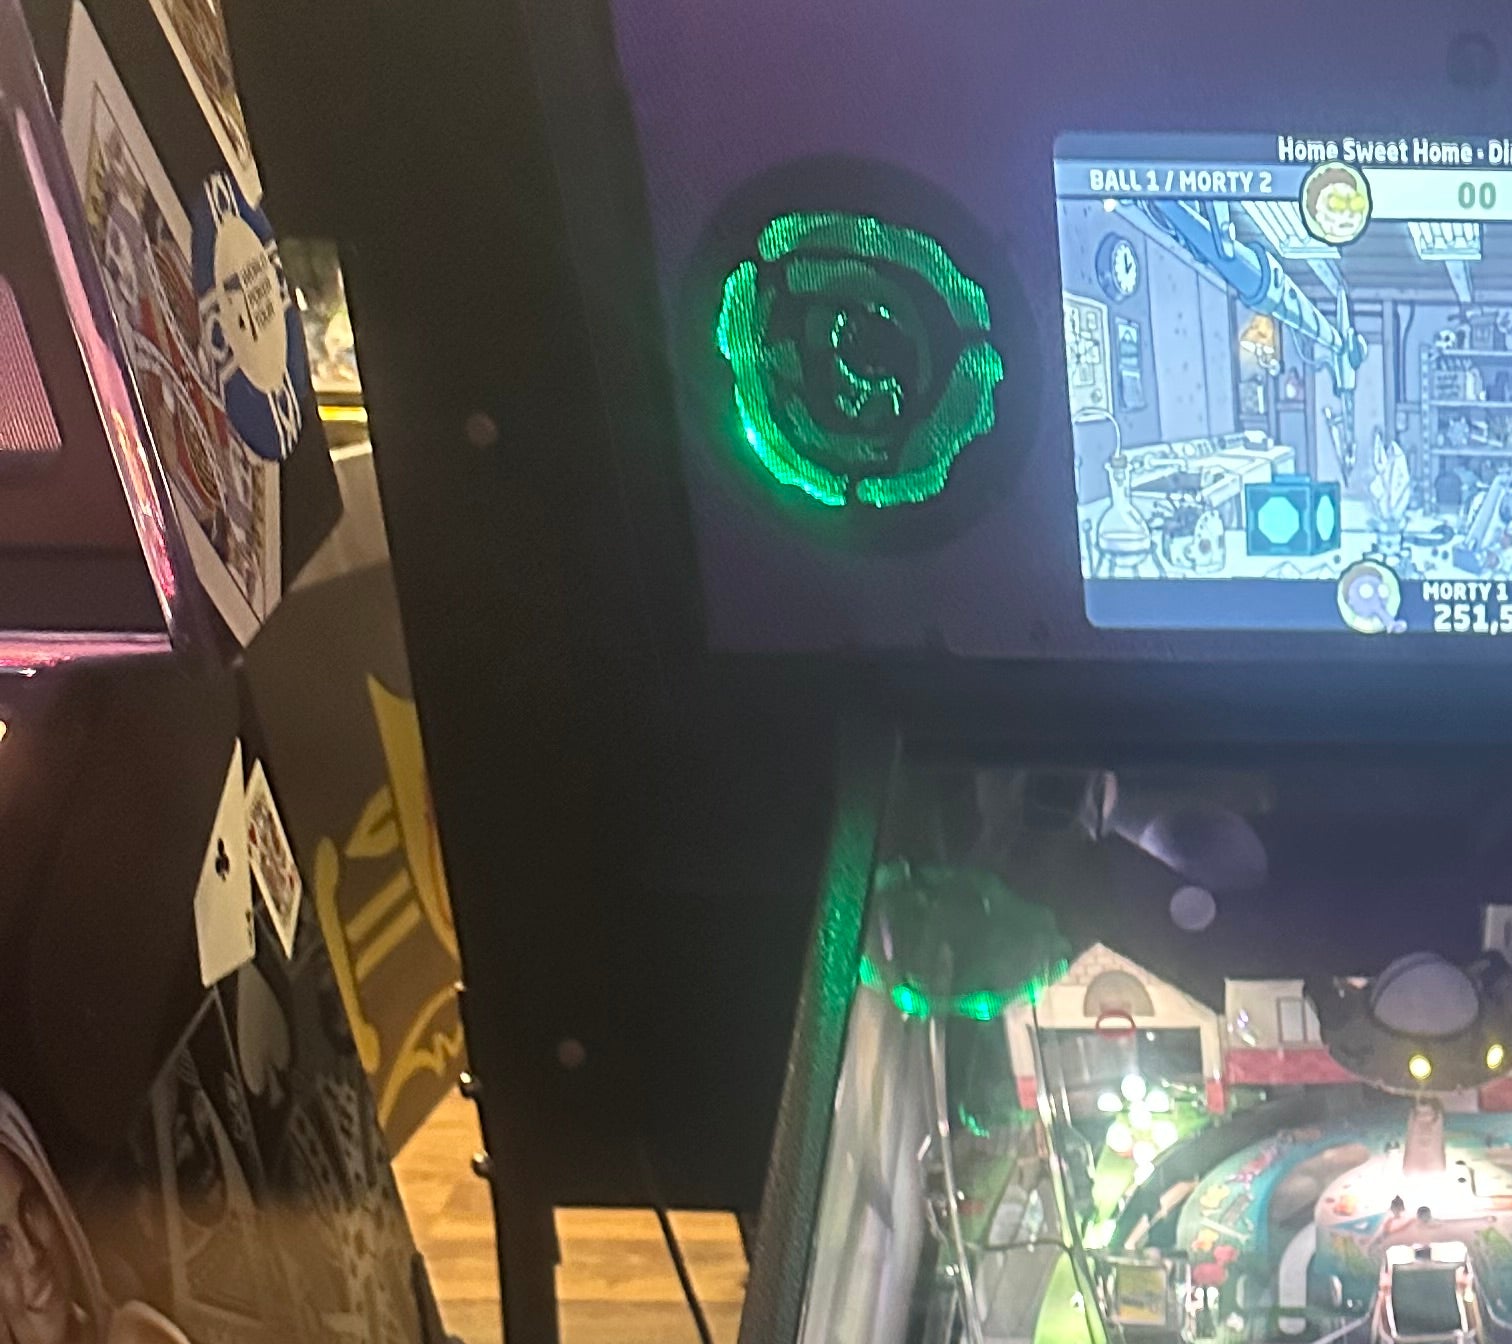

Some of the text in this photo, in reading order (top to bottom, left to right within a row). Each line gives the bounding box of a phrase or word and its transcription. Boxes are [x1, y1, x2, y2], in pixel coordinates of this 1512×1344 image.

[1278, 136, 1338, 162] Home
[1343, 138, 1407, 163] Sweet
[1414, 138, 1473, 164] Home
[1089, 168, 1143, 194] BALL
[1145, 170, 1159, 193] 1
[1180, 171, 1253, 195] MORTY
[1257, 172, 1272, 195] 2
[1458, 181, 1497, 209] 00
[1423, 582, 1508, 601] MORTY 1
